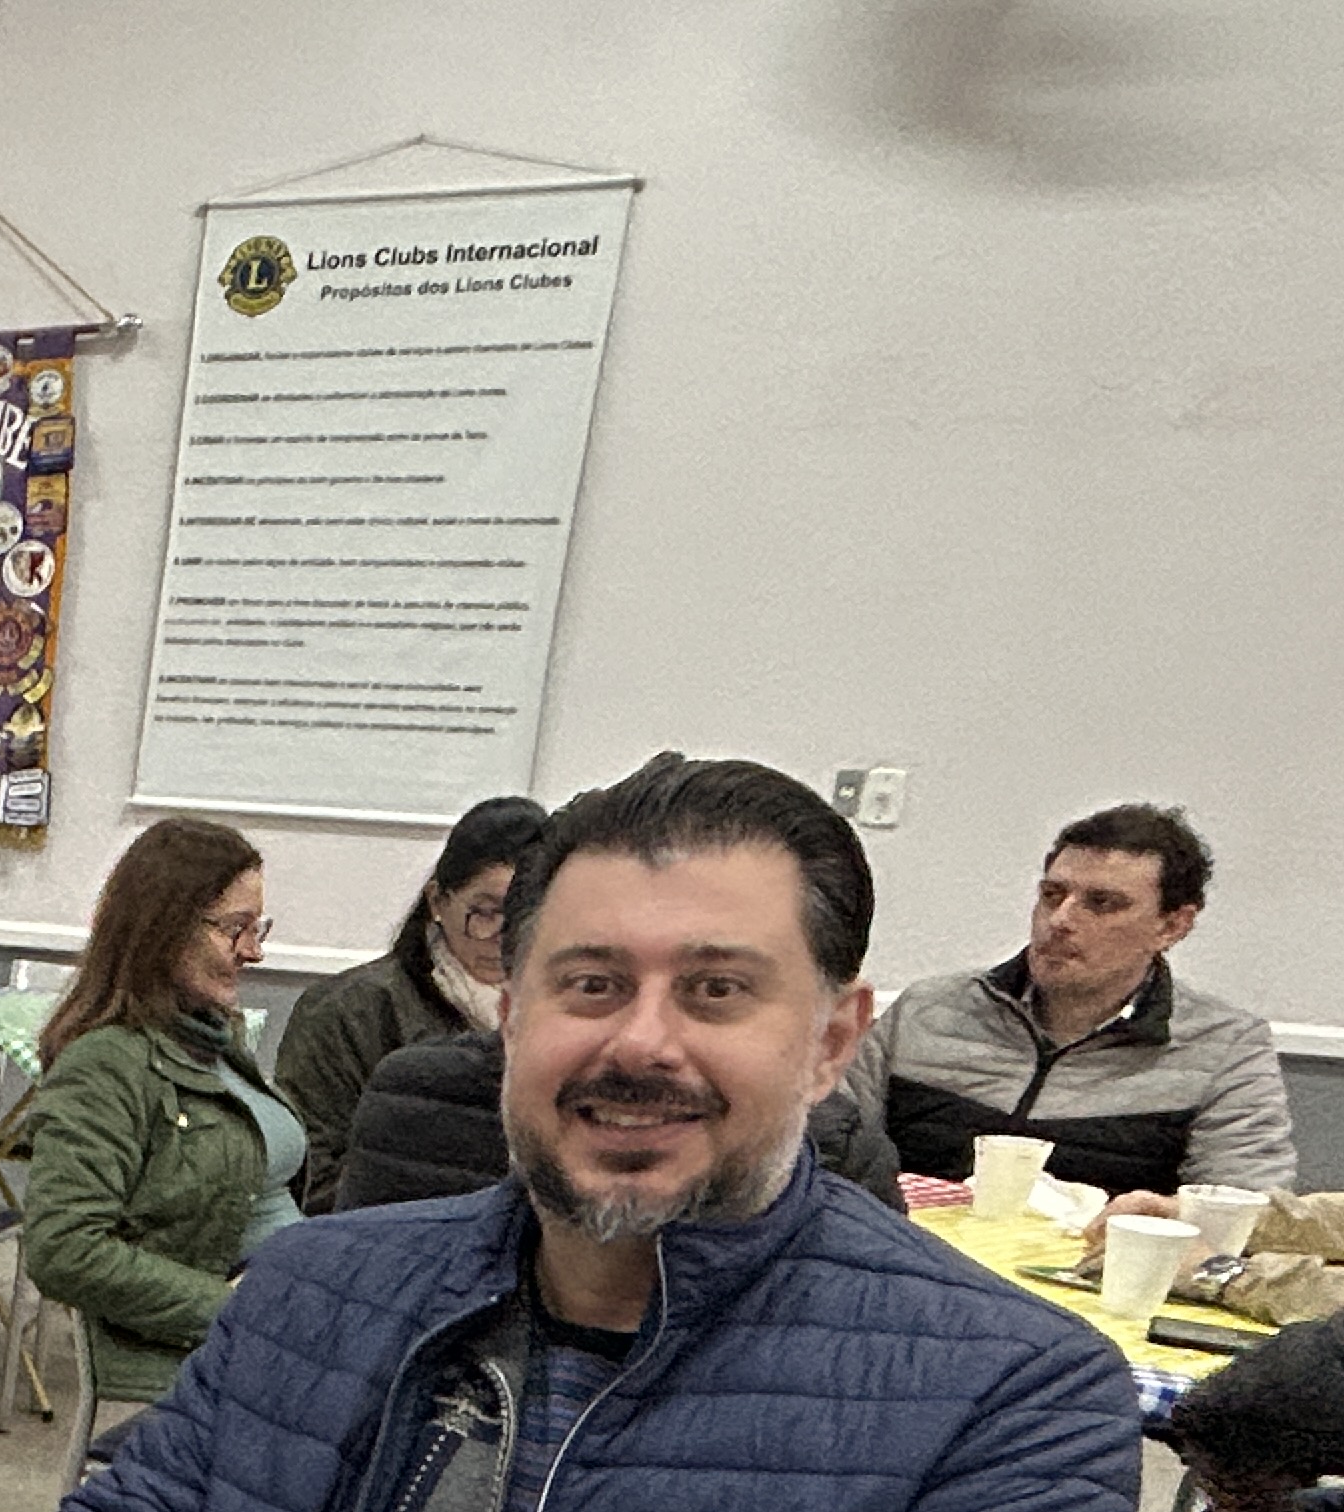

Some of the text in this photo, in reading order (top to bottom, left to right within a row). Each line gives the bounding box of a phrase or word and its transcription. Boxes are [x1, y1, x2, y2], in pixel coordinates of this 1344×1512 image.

[306, 235, 600, 271] Lions Clubs Internacional
[320, 271, 573, 301] Propósitos dos Lions Clubes
